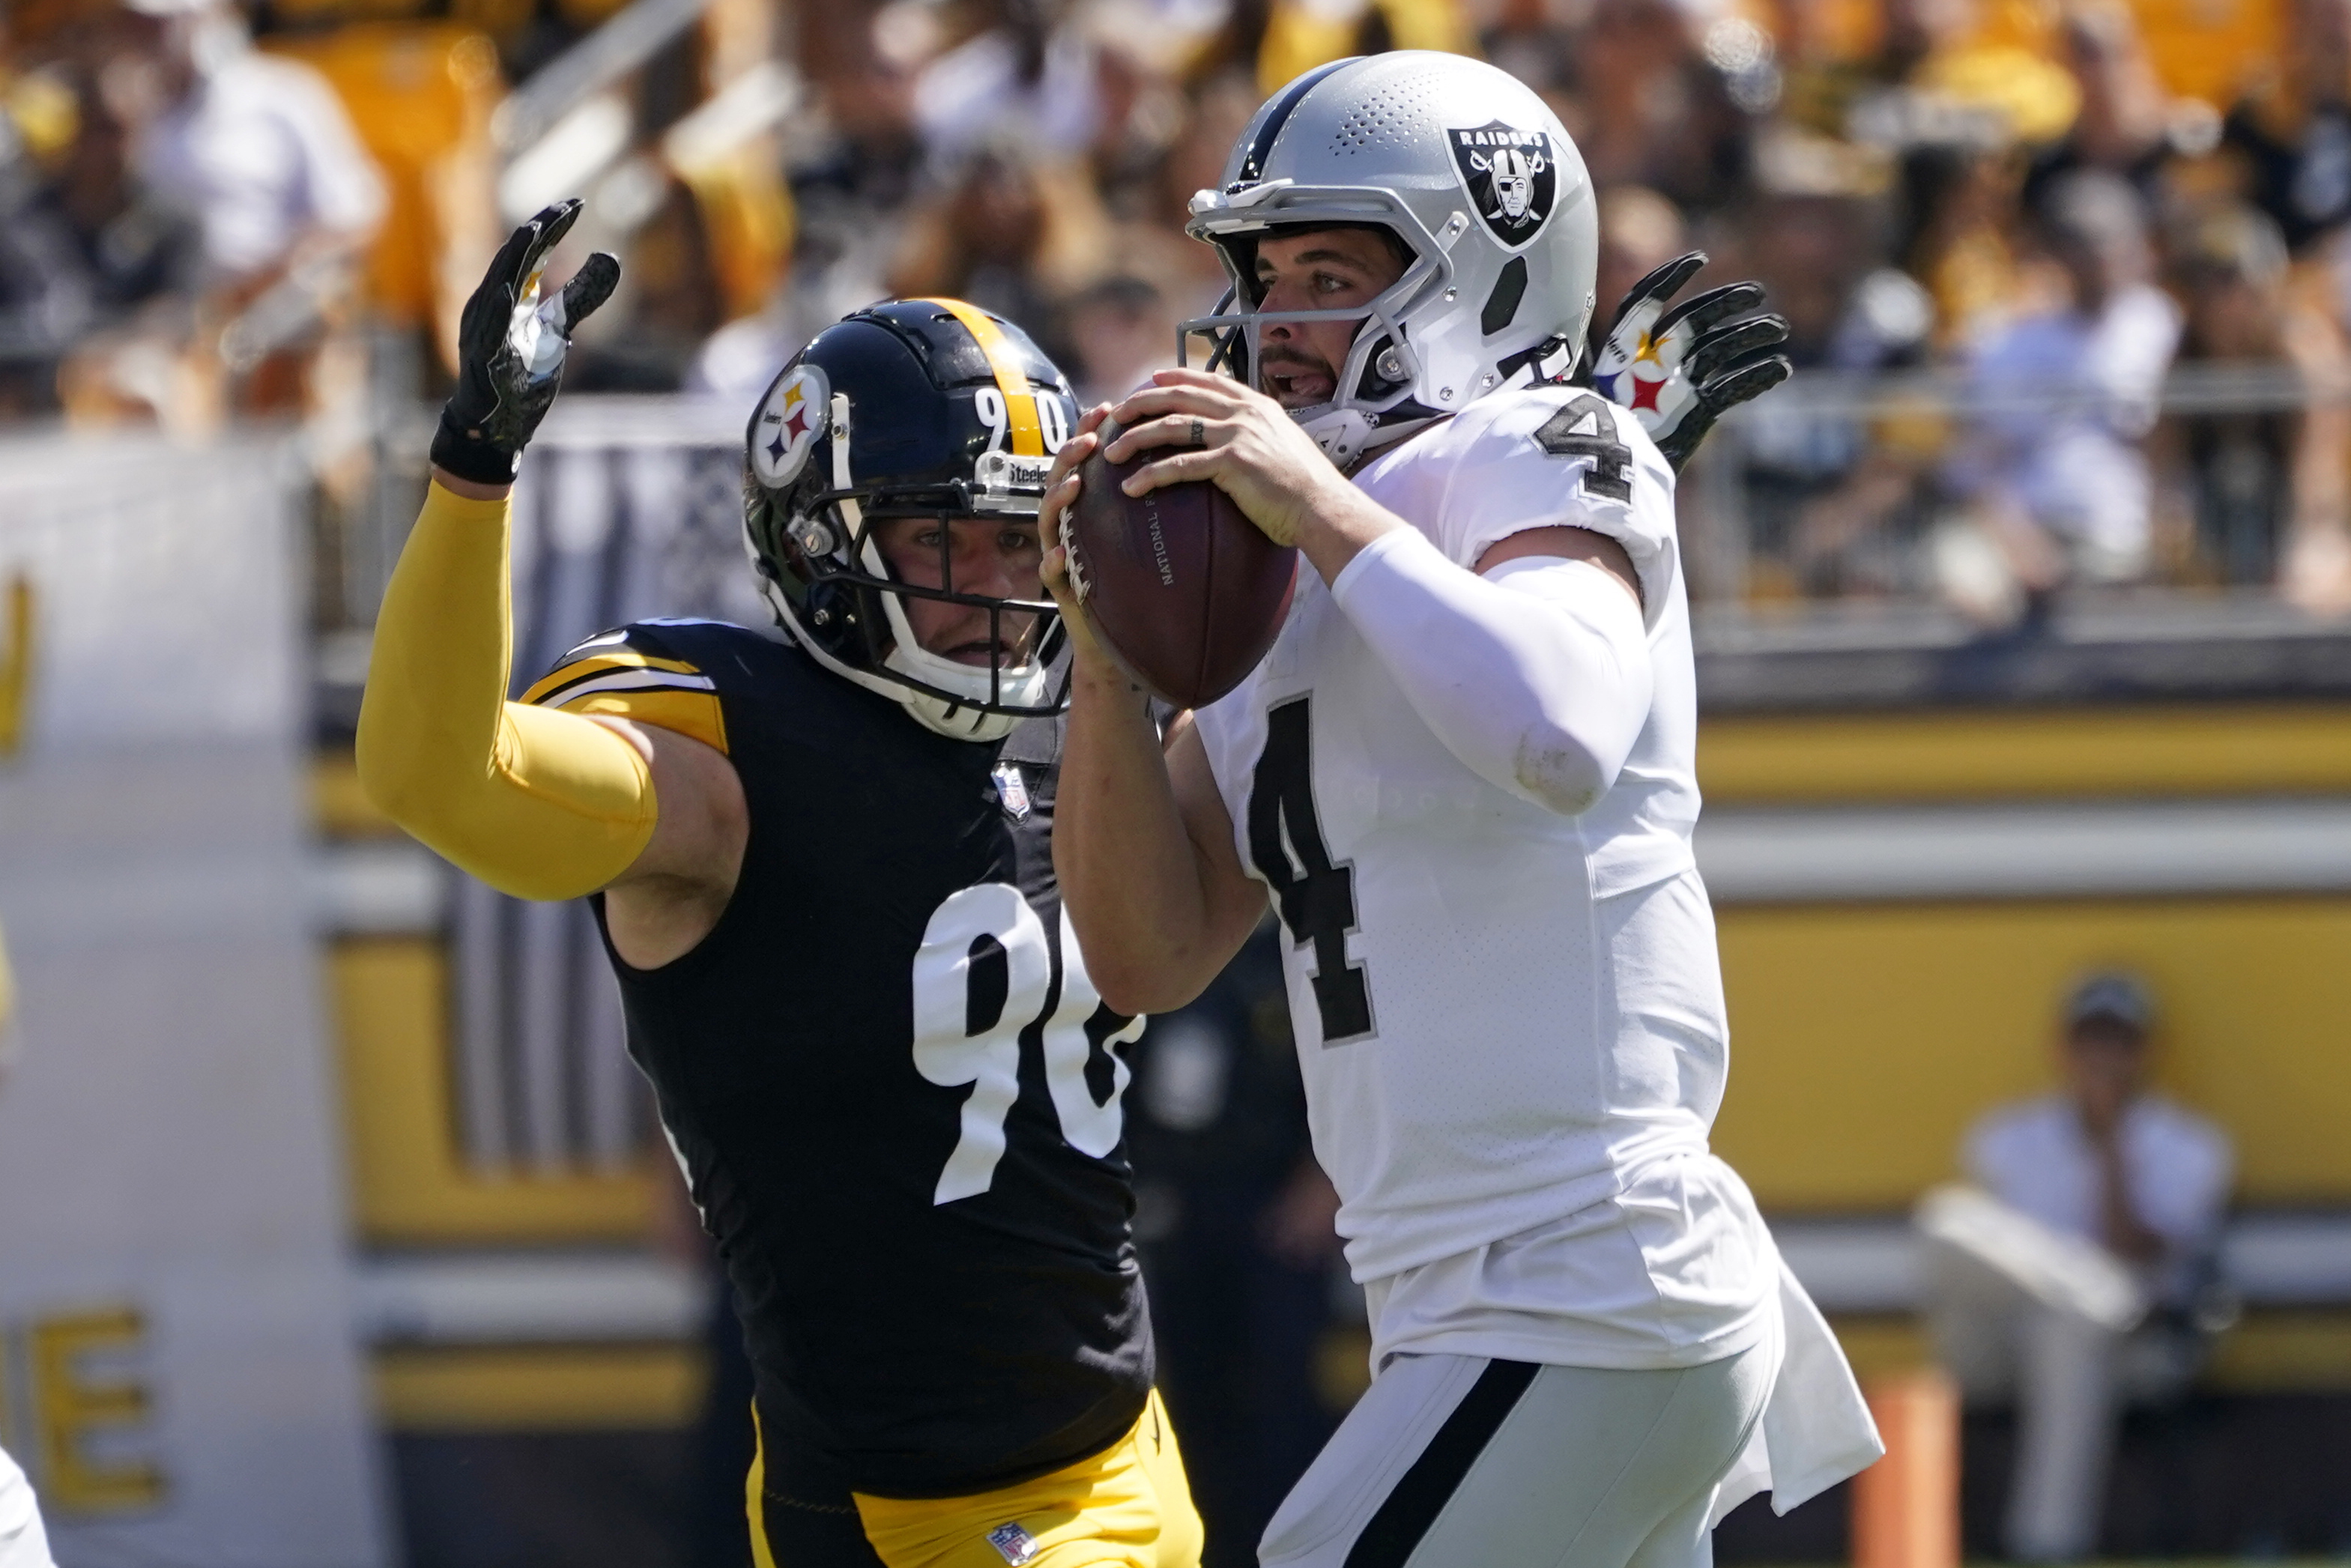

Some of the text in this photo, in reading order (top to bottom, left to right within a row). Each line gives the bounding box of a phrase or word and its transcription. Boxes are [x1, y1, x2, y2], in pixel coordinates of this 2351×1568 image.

[1459, 131, 1543, 147] RAIDERS
[975, 388, 1067, 454] 90
[1530, 393, 1633, 509] 4
[1009, 463, 1047, 482] Steele
[1149, 512, 1173, 585] NATIONAL
[1248, 689, 1379, 1049] 4
[913, 883, 1146, 1205] 90
[0, 1310, 165, 1512] E
